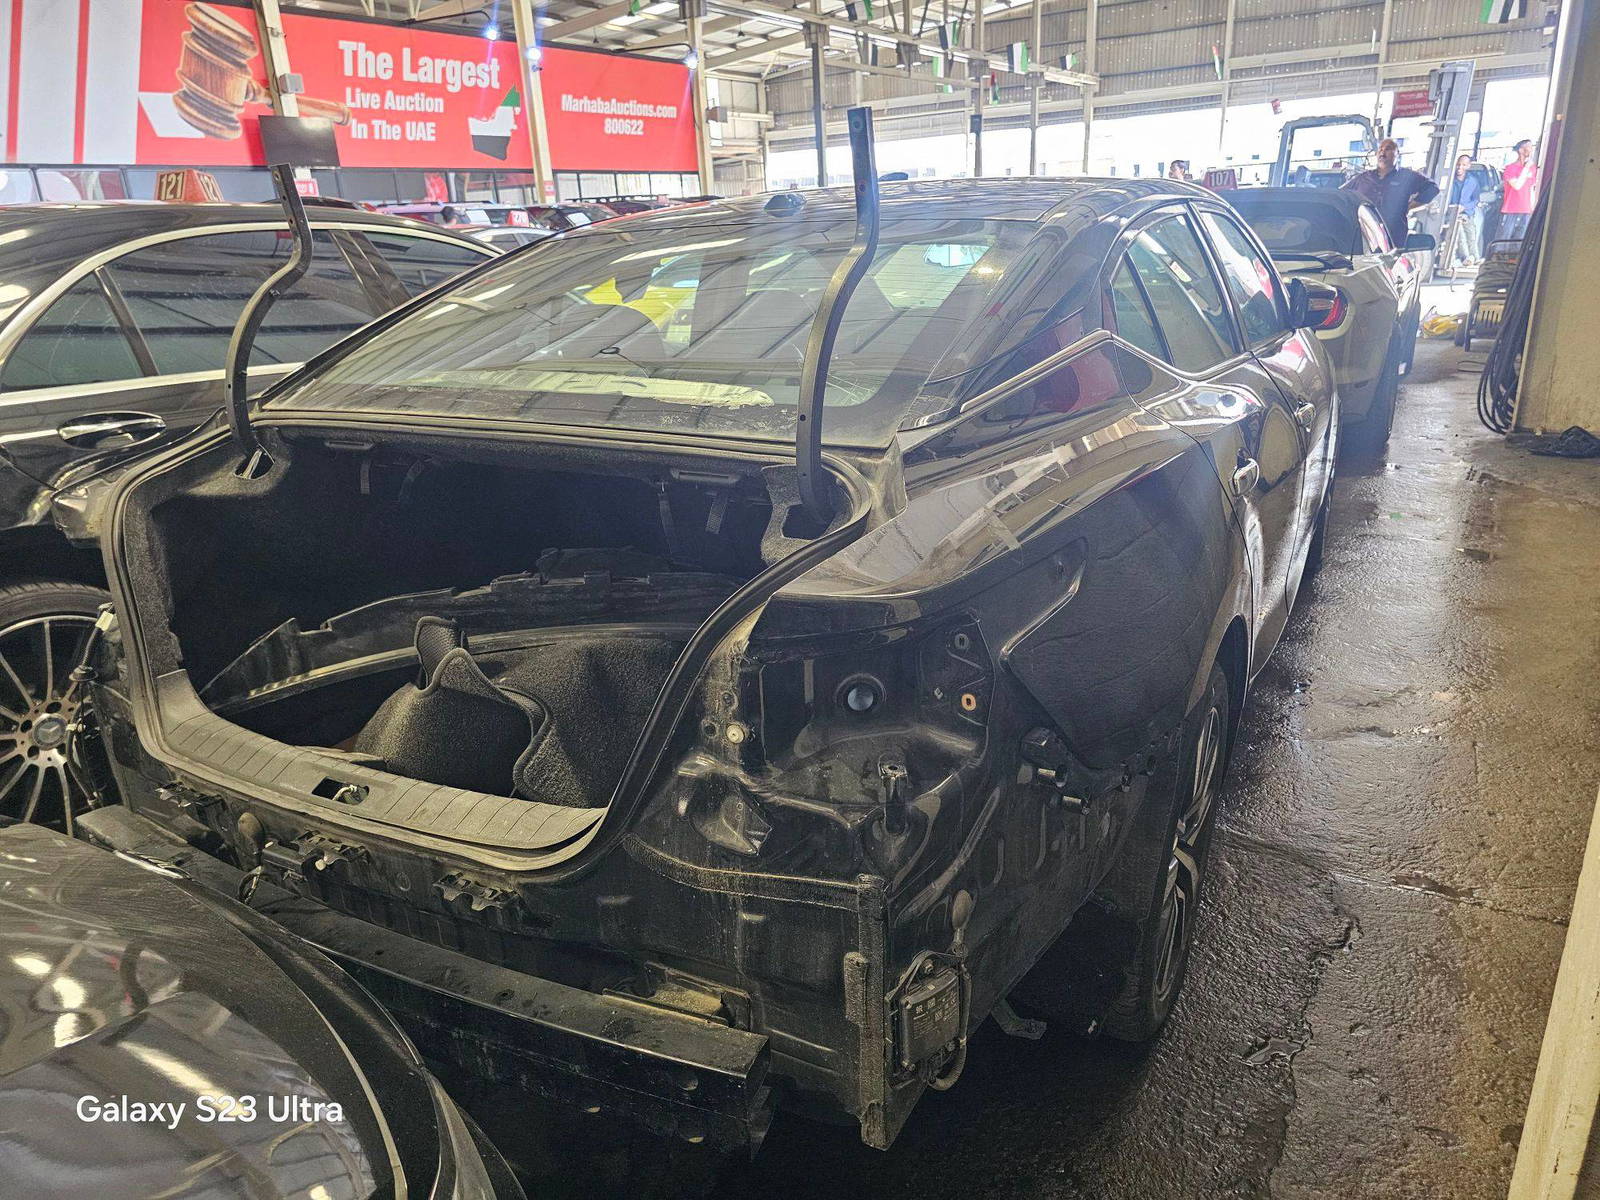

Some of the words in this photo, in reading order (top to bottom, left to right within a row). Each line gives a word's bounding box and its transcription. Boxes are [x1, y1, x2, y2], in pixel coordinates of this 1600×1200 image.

[338, 40, 394, 80] The
[402, 47, 500, 93] Largest
[345, 87, 381, 109] Live
[384, 90, 444, 113] Auction
[561, 94, 677, 118] MarhabaAuctions.com
[351, 119, 368, 139] In
[371, 120, 402, 140] The
[405, 121, 437, 141] UAE
[604, 117, 644, 136] 800622
[160, 171, 184, 201] 121
[1210, 171, 1230, 187] 107
